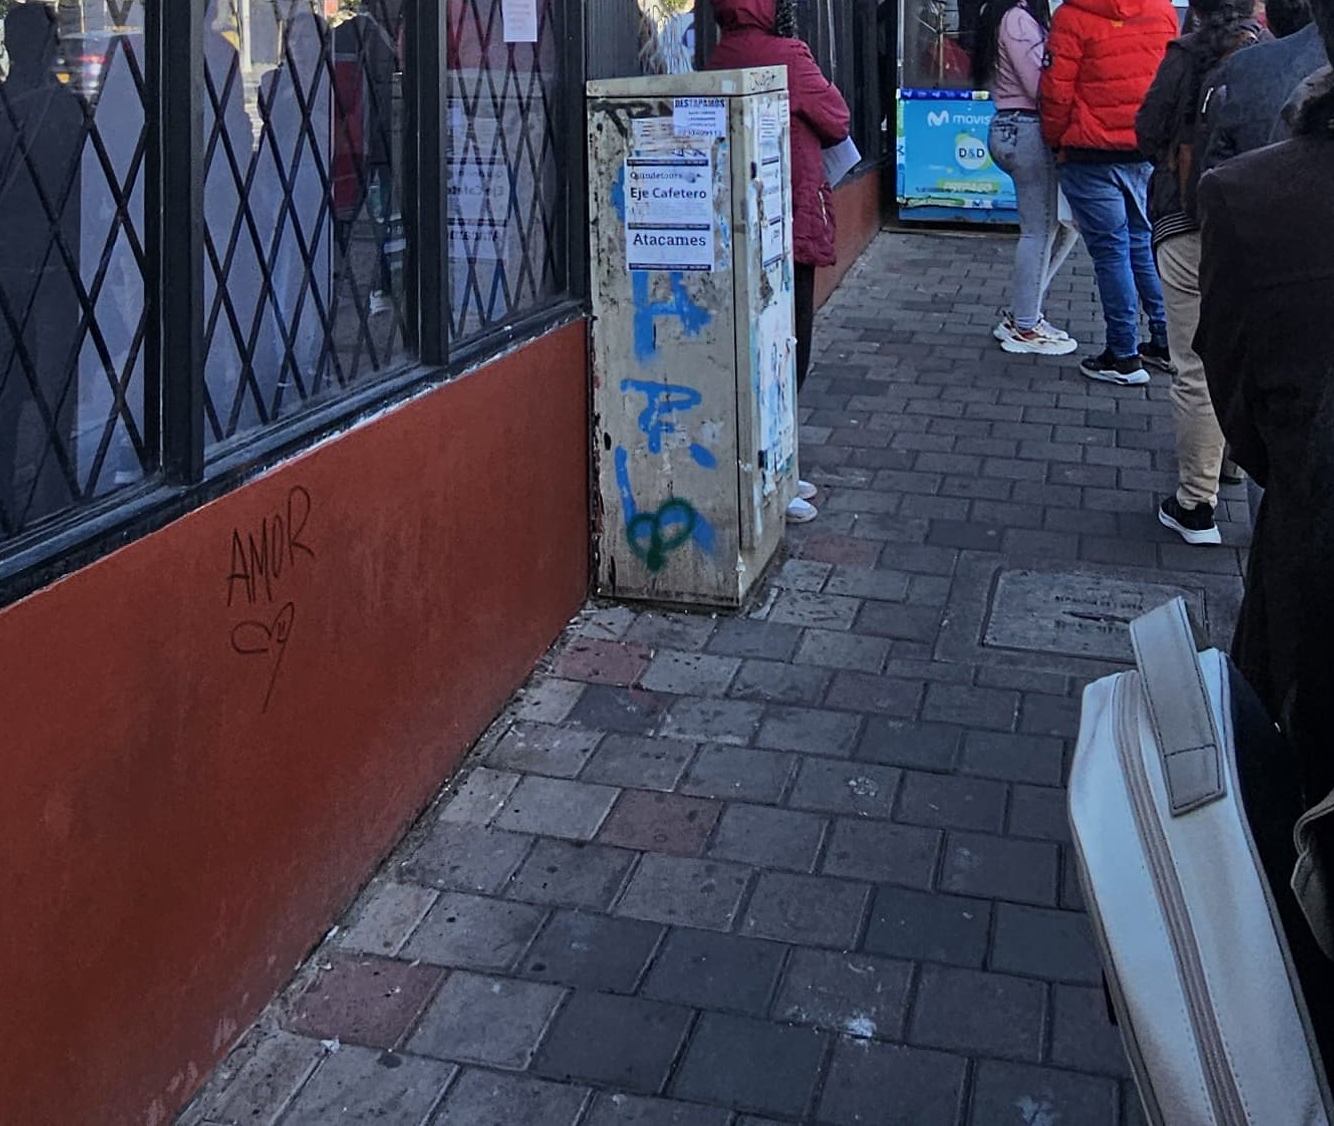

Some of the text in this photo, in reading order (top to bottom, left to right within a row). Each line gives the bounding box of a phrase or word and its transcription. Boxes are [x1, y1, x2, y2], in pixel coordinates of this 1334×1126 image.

[952, 115, 990, 124] movis
[630, 187, 707, 201] Eje Cafetero
[633, 233, 706, 246] Atacames
[227, 485, 315, 607] AMOR
